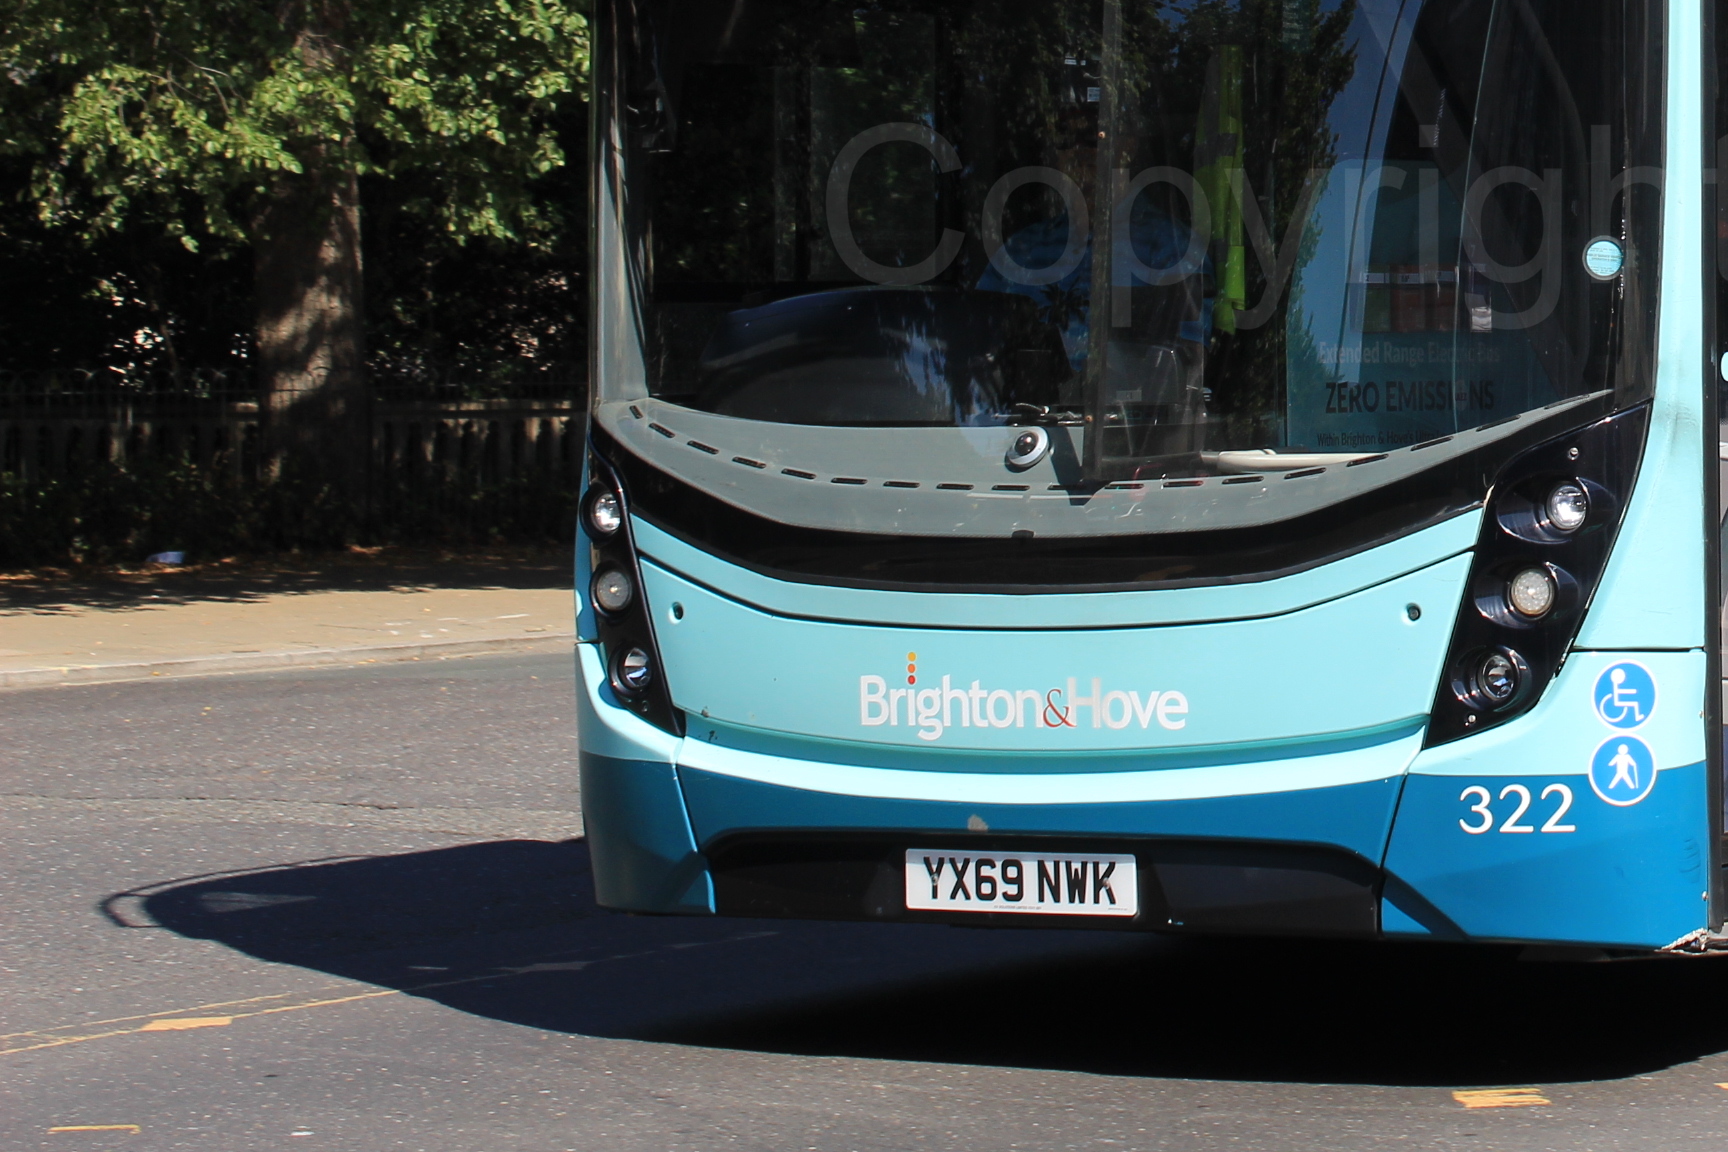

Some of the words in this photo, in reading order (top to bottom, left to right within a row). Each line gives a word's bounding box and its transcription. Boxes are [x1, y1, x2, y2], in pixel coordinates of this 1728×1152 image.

[1383, 341, 1424, 367] Range
[1325, 381, 1379, 414] ZERO
[1317, 432, 1340, 447] Within
[1341, 430, 1376, 449] Brighton
[860, 652, 1188, 741] Brighton&Hove
[1459, 783, 1576, 835] 322
[923, 856, 1024, 902] YX69
[1037, 859, 1116, 905] NWK
